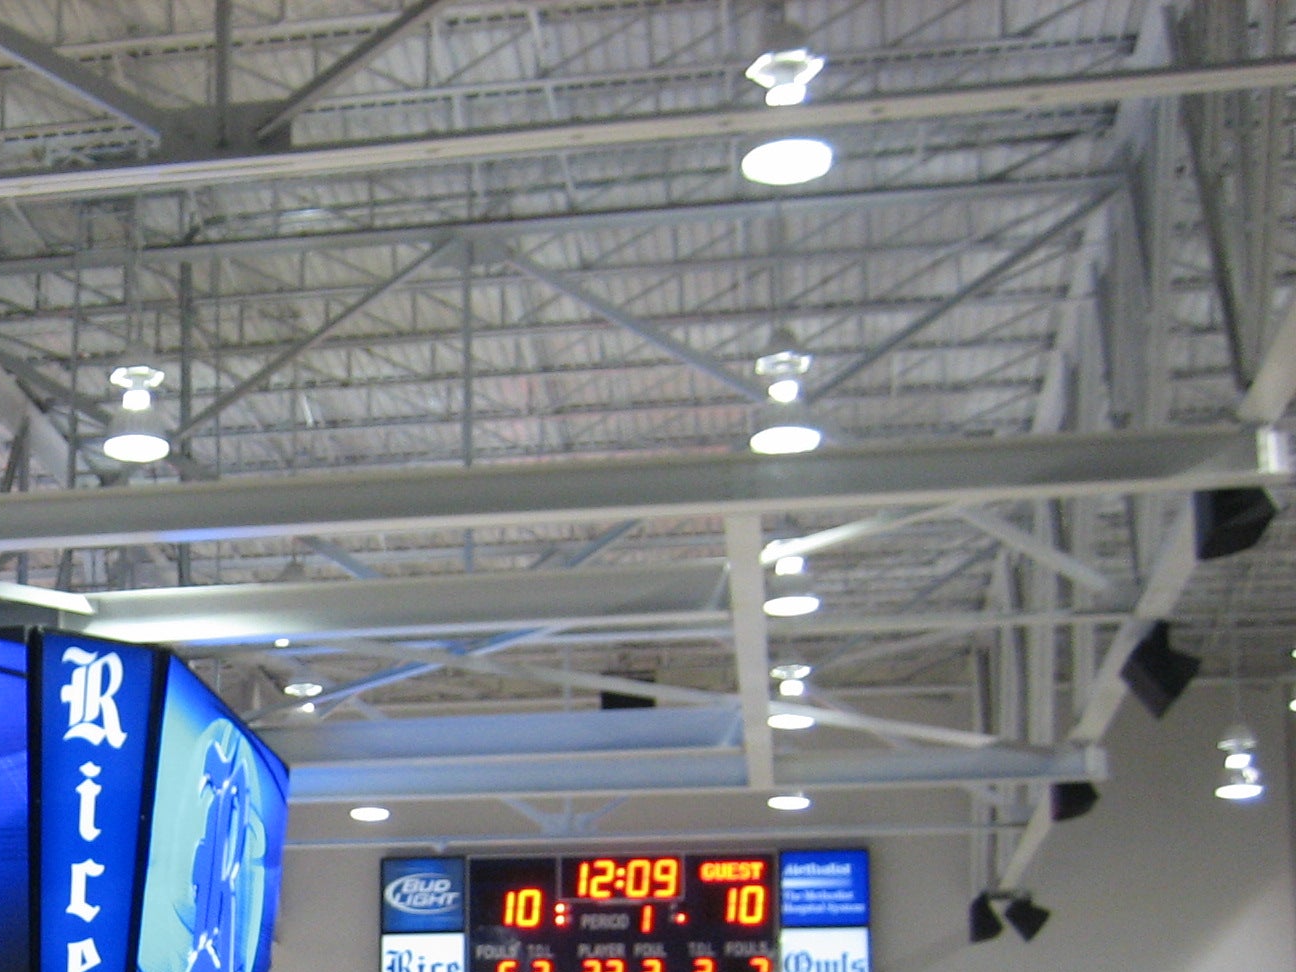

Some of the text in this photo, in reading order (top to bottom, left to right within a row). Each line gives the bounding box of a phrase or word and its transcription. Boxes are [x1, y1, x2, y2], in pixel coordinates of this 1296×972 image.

[401, 877, 452, 893] BUD
[577, 858, 678, 898] 12:09
[701, 861, 765, 881] GUEST
[395, 891, 461, 907] LIGHT
[504, 888, 542, 927] 10
[725, 884, 766, 924] 10
